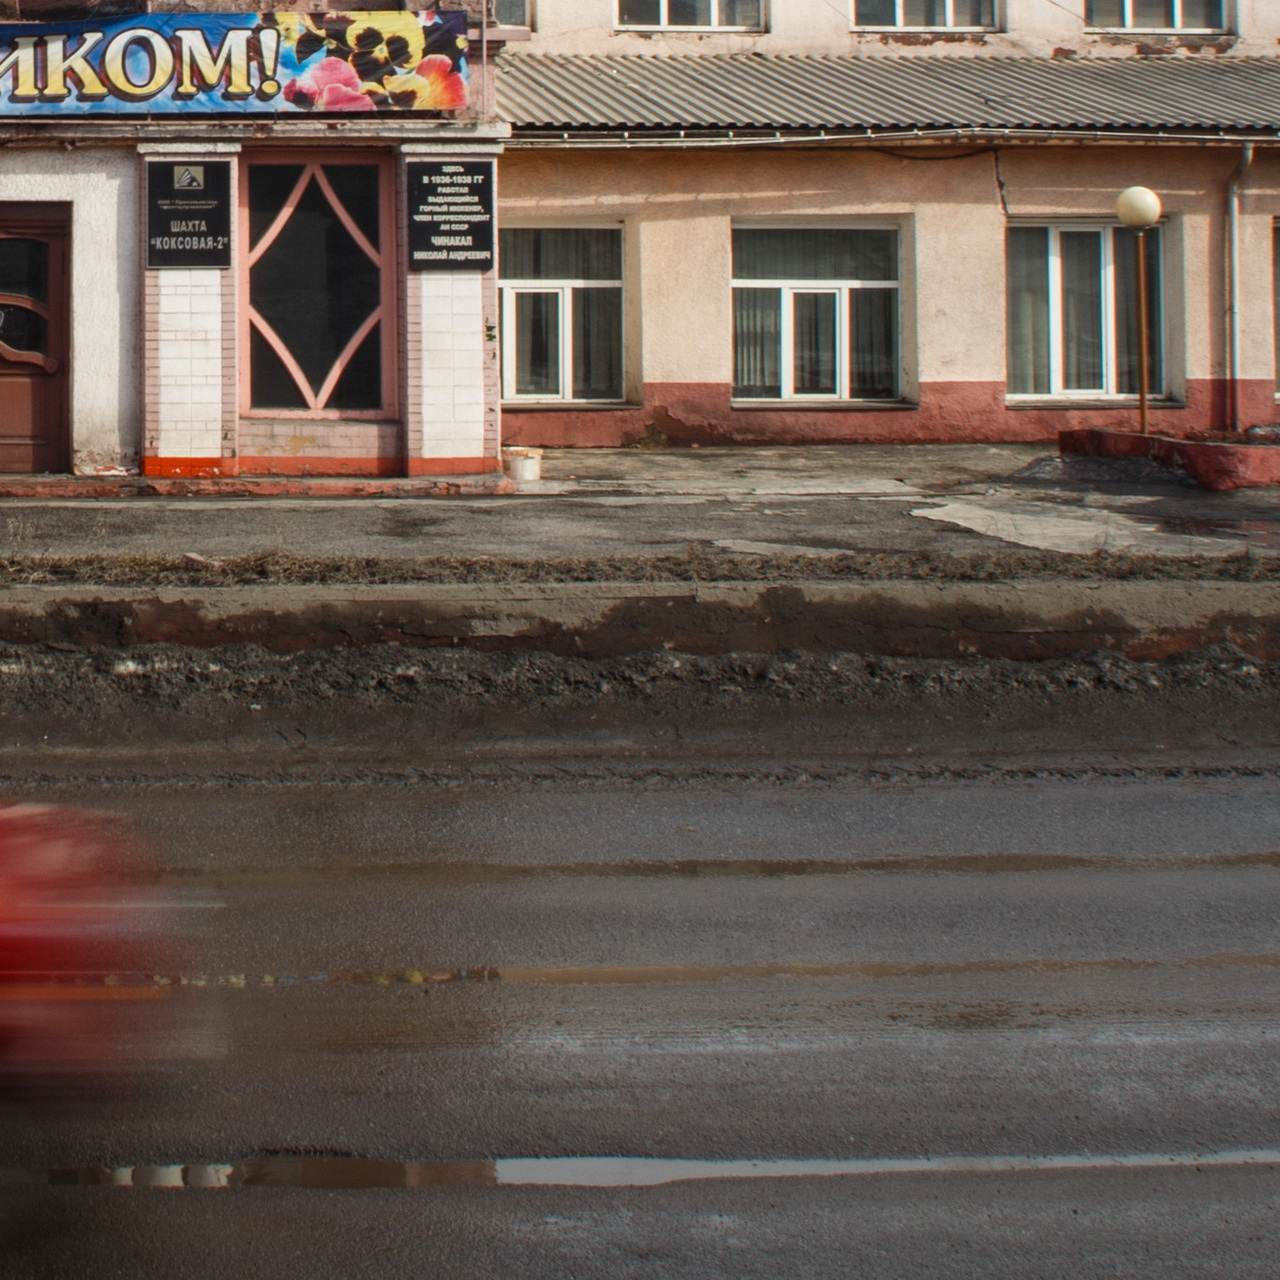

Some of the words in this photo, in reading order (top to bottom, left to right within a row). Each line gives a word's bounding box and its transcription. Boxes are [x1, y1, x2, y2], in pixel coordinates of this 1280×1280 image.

[422, 175, 429, 184] В
[170, 220, 207, 232] ШАХТА
[413, 249, 448, 260] НИКОЛАЙ
